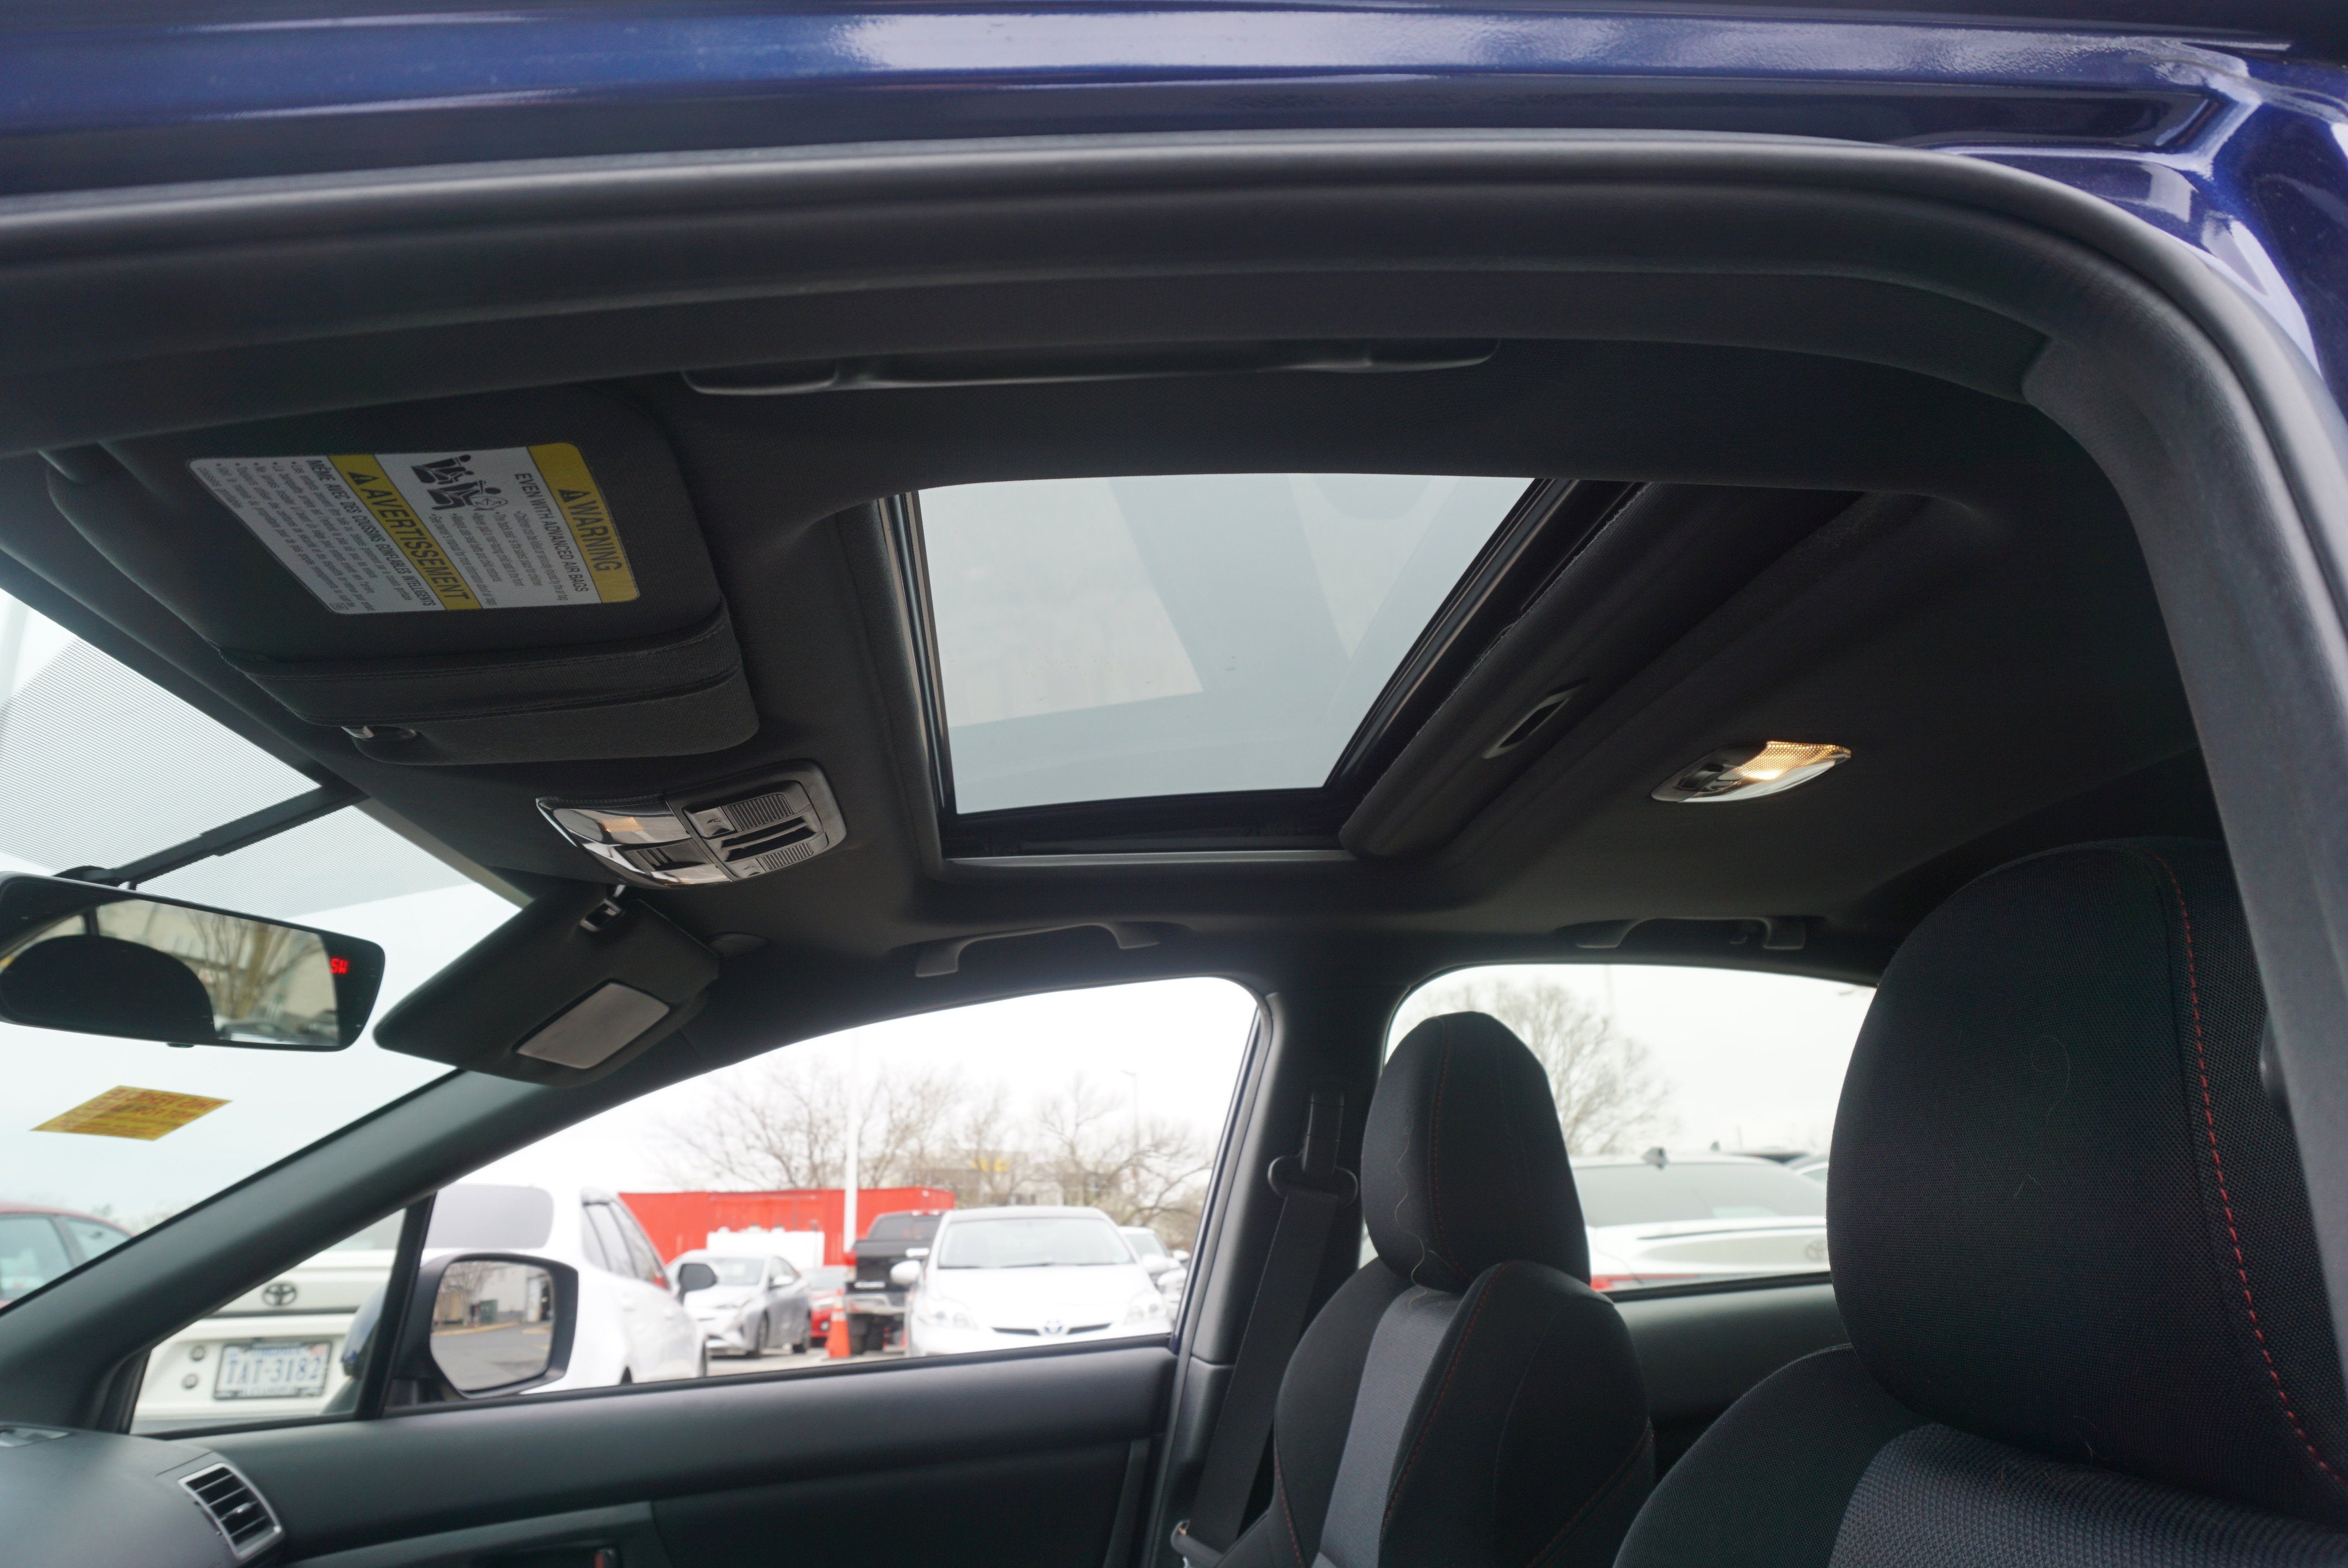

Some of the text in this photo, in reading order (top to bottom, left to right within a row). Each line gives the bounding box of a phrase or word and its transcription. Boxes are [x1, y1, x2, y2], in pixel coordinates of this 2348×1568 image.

[324, 483, 353, 499] AVEC
[339, 501, 364, 513] DES
[350, 515, 386, 541] COUSSINS
[514, 473, 591, 592] EVEN WITH ADVANCED AIR BAGS
[565, 500, 625, 571] WARNING
[358, 487, 471, 600] AVERTISSEMENT
[373, 544, 412, 574] GONFLABLES
[399, 575, 437, 606] INTELLIGENTS
[330, 957, 349, 974] SW
